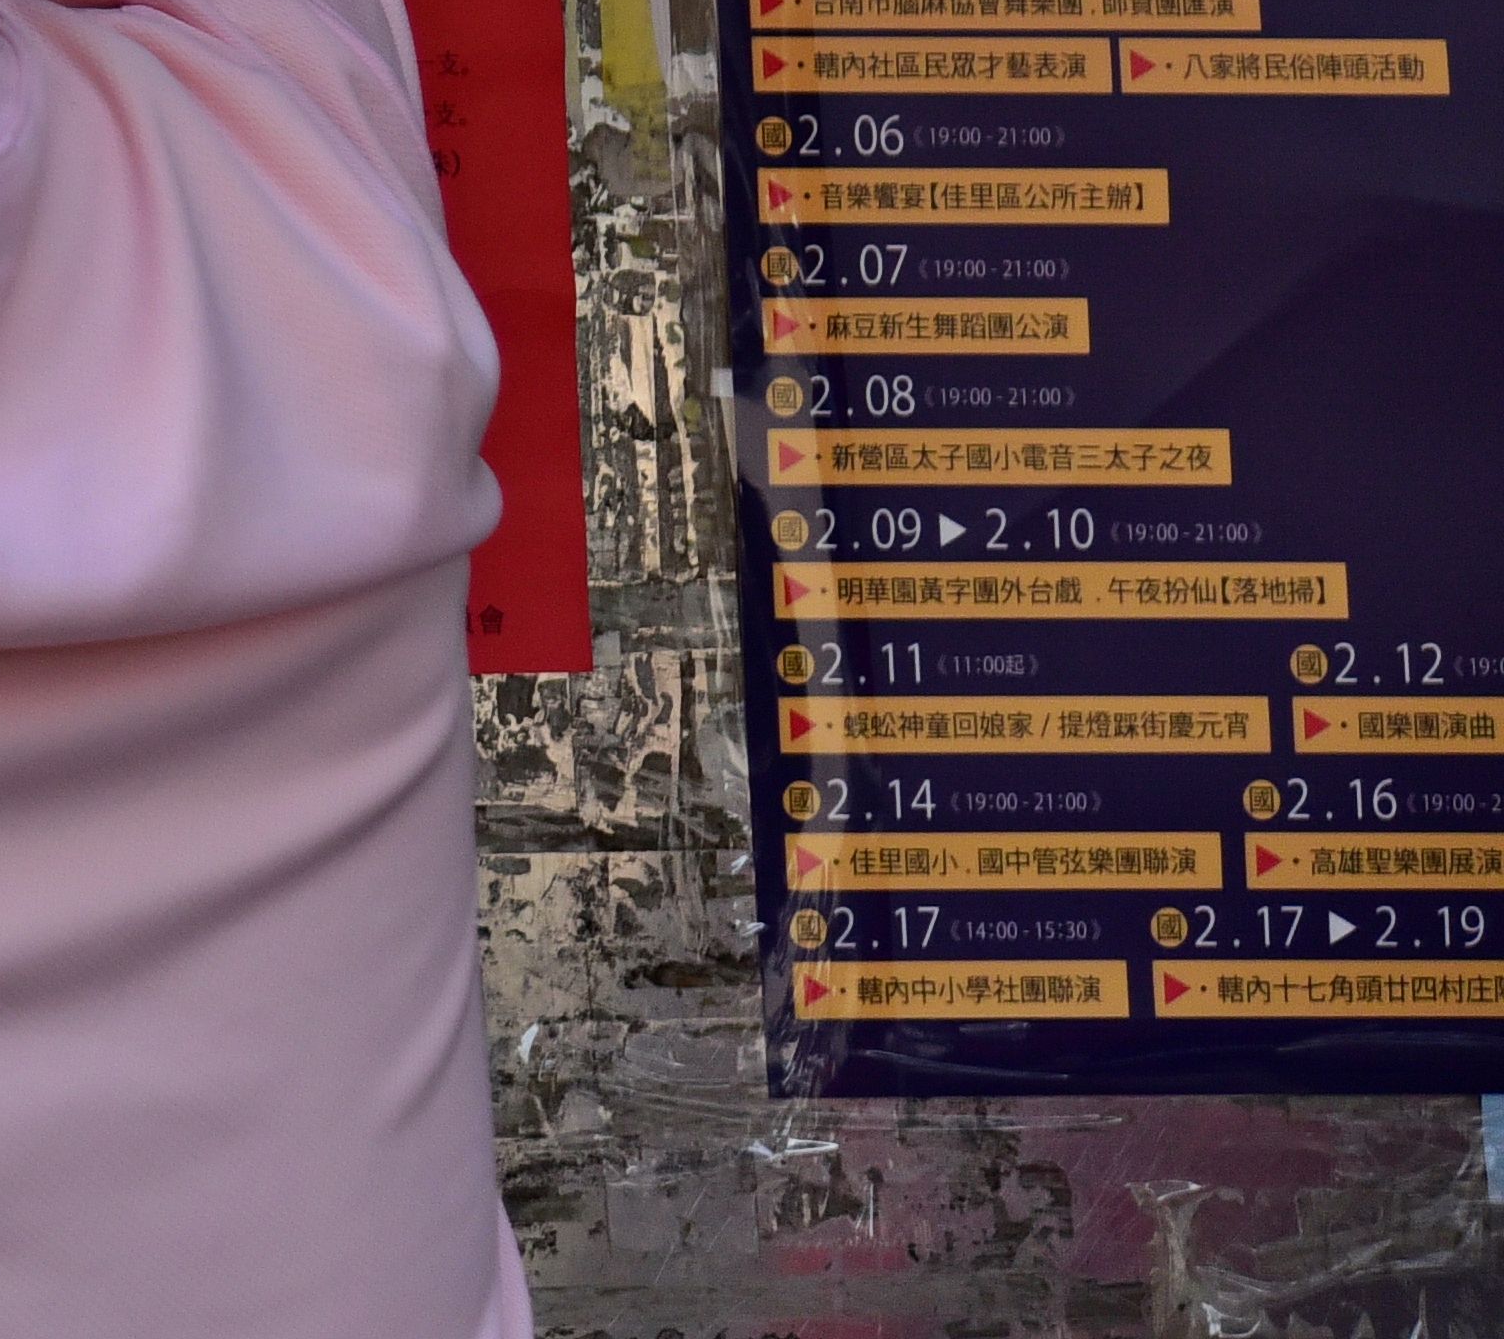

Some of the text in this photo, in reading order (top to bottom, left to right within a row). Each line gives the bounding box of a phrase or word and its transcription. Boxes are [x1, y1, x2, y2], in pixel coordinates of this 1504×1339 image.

[813, 50, 1088, 81] 轄內社區民眾才藝表演
[1183, 52, 1426, 83] 八家將民俗陣頭活動
[825, 311, 1070, 342] 麻豆新生舞蹈團公演
[857, 975, 1102, 1006] 轄內中小學社團聯演
